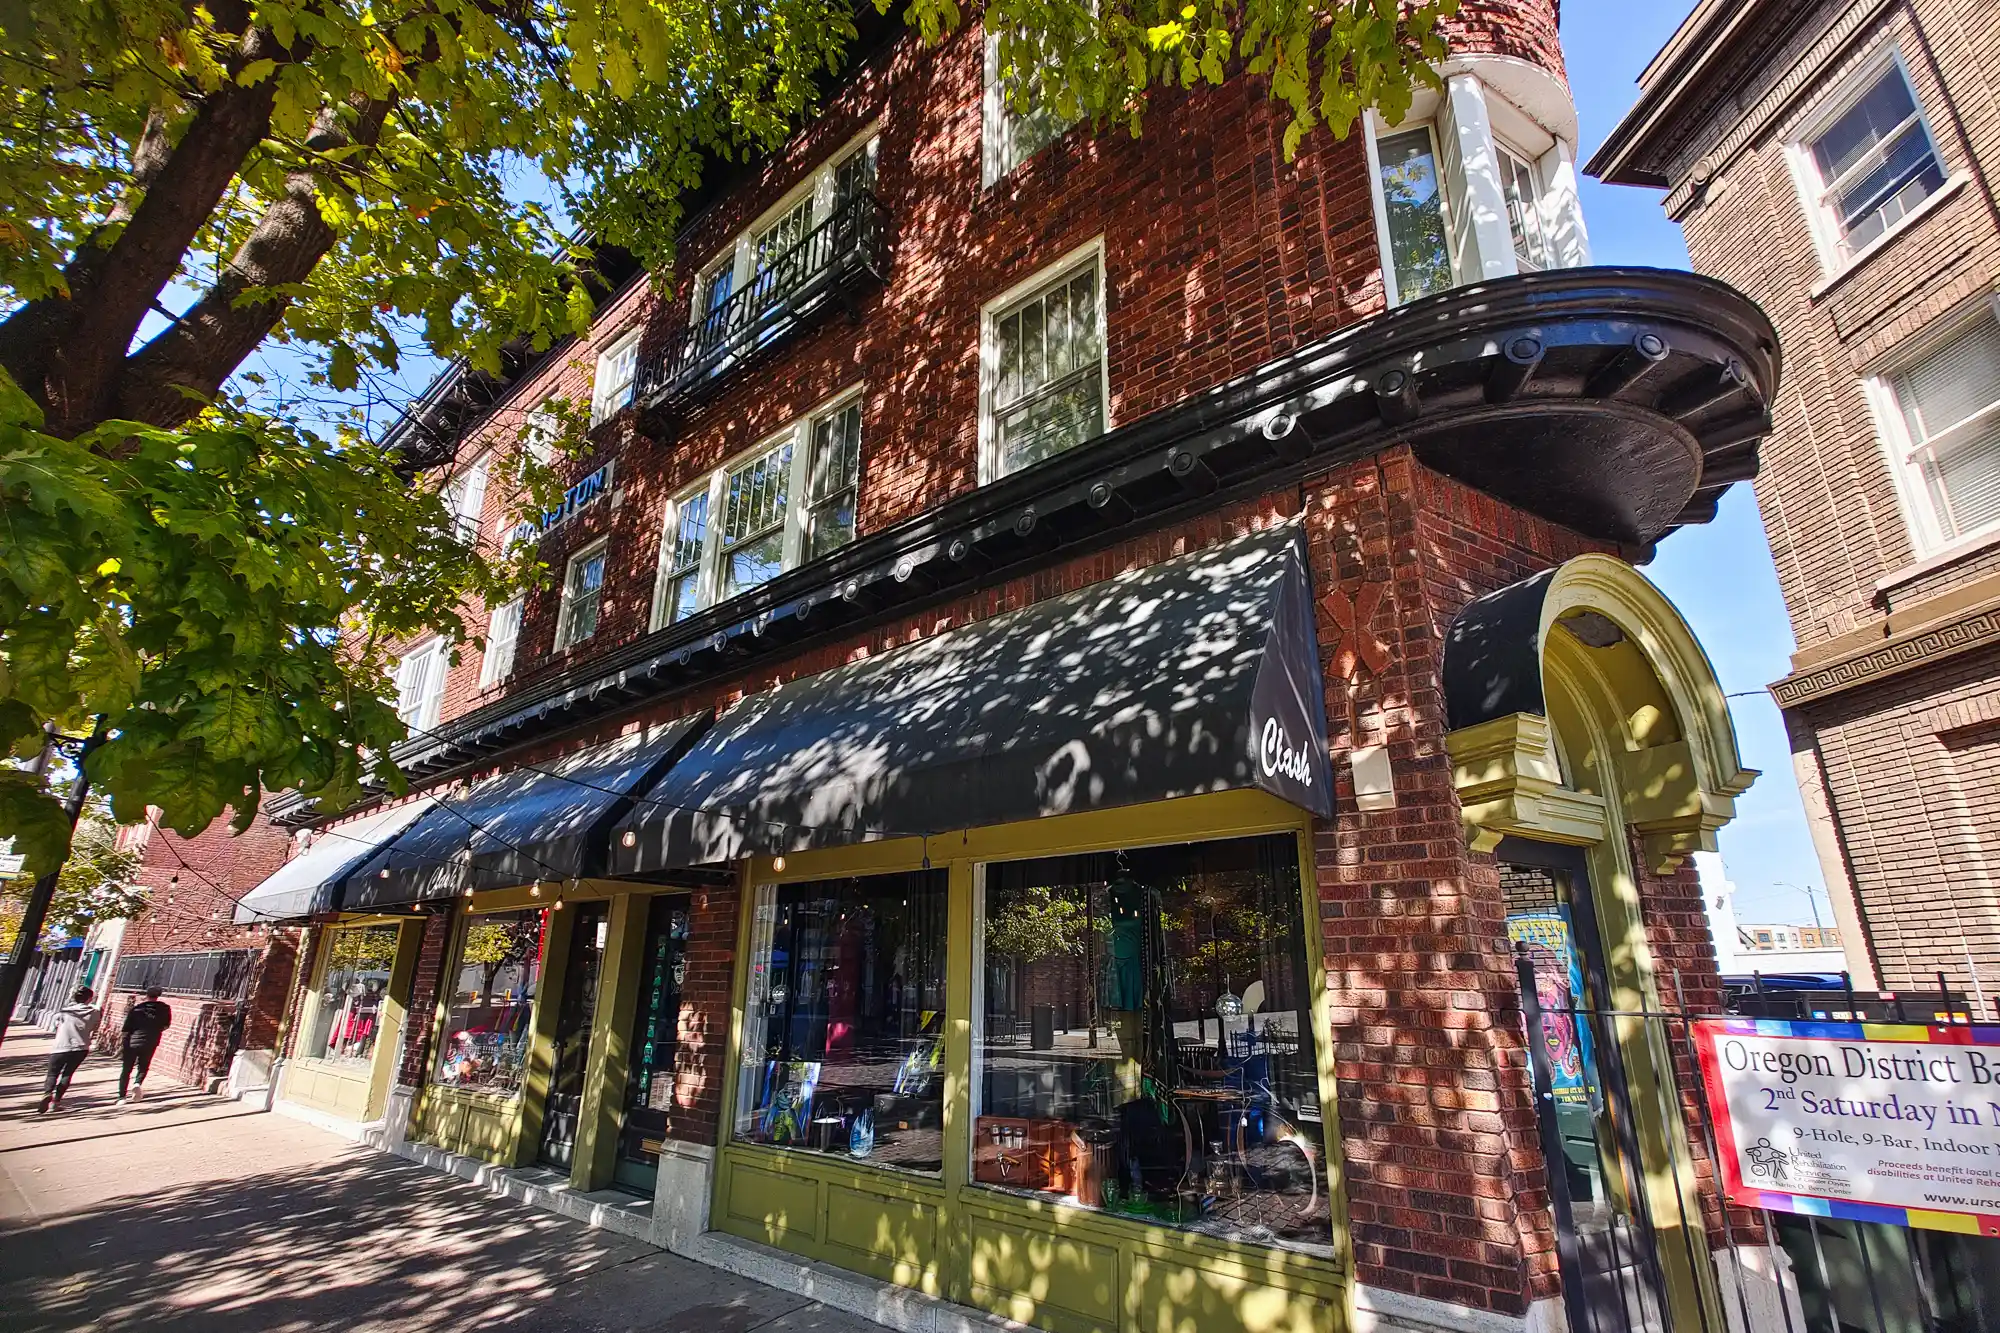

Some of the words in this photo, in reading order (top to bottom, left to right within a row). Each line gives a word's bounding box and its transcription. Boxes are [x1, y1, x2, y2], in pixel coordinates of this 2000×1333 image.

[1261, 717, 1312, 787] Clash
[426, 864, 459, 895] Clash
[1724, 1040, 1835, 1084] Oregon
[1839, 1046, 1961, 1083] District
[1760, 1087, 1796, 1111] 2nd
[1801, 1090, 1938, 1131] Saturday
[1945, 1100, 1983, 1126] in
[1788, 1146, 1822, 1159] United
[1793, 1127, 1859, 1146] 9-Hole,
[1862, 1133, 1919, 1151] 9-Bar,
[1922, 1137, 1990, 1155] Indoor
[1867, 1168, 1920, 1180] disabilities
[1923, 1172, 1935, 1181] at
[1937, 1174, 1973, 1185] United
[1878, 1159, 1923, 1171] Proceeds
[1926, 1163, 1963, 1175] benefit
[1966, 1167, 1992, 1178] local
